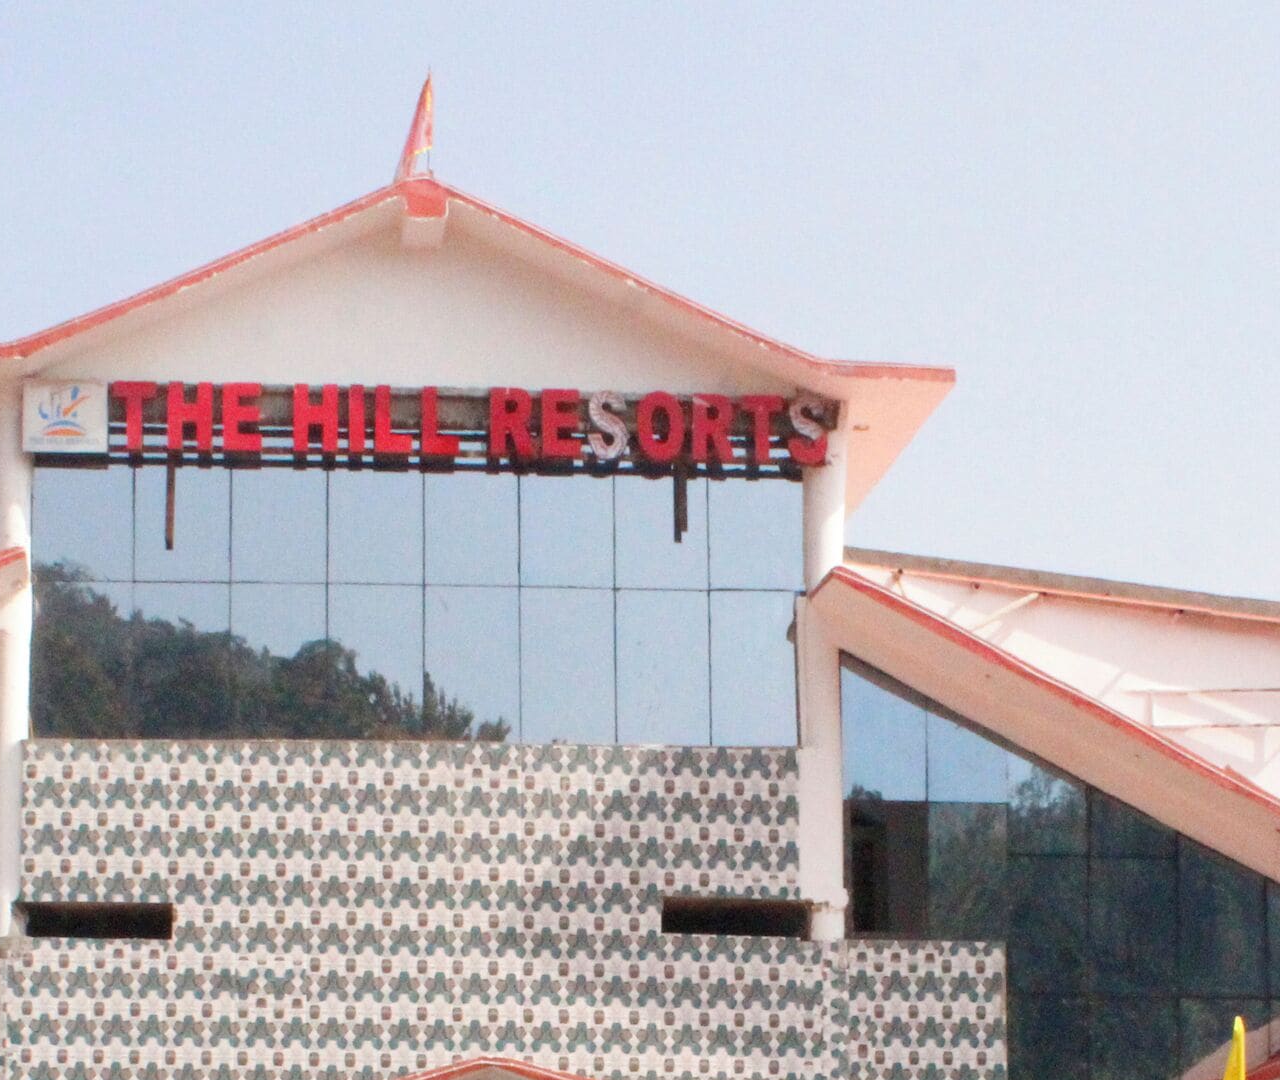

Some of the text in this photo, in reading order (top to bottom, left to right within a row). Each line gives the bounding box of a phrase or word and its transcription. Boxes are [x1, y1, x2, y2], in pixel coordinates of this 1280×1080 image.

[111, 380, 829, 468] THE HILL RESORTS
